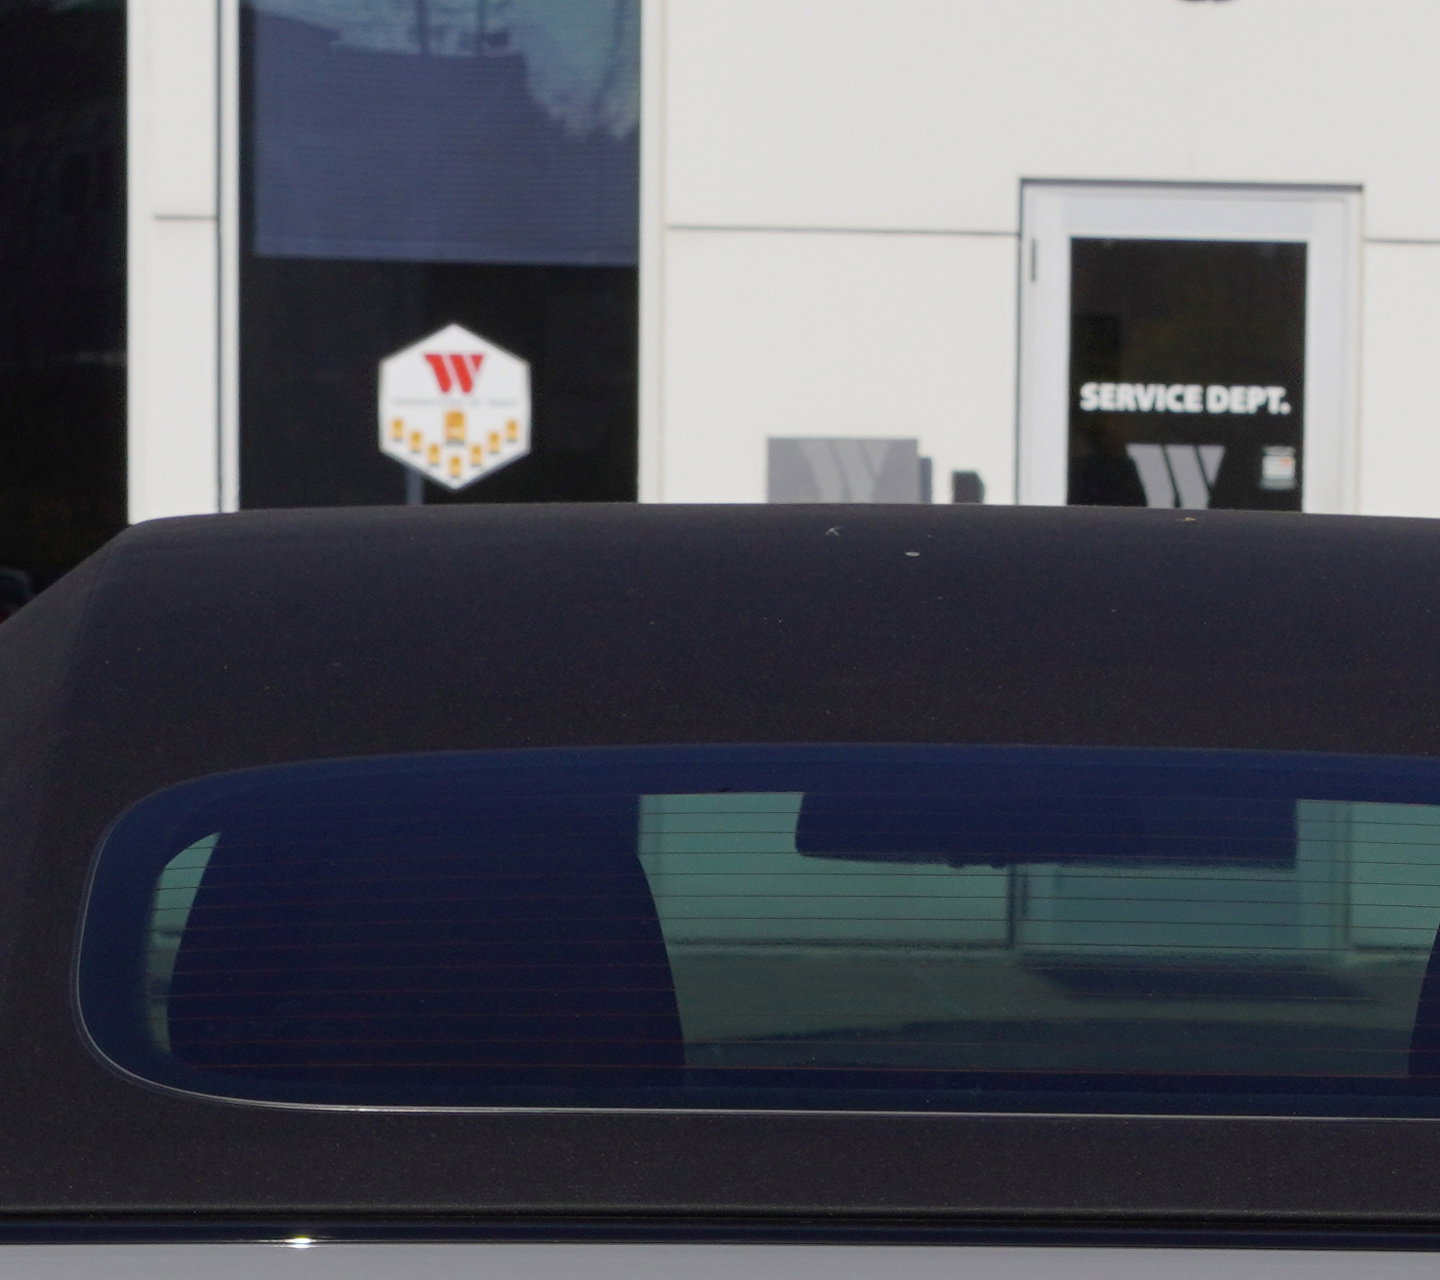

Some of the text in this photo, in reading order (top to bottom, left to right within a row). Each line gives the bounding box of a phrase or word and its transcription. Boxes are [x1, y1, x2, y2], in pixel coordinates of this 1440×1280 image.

[424, 354, 486, 394] W
[1079, 381, 1292, 415] SERVICE DEPT.
